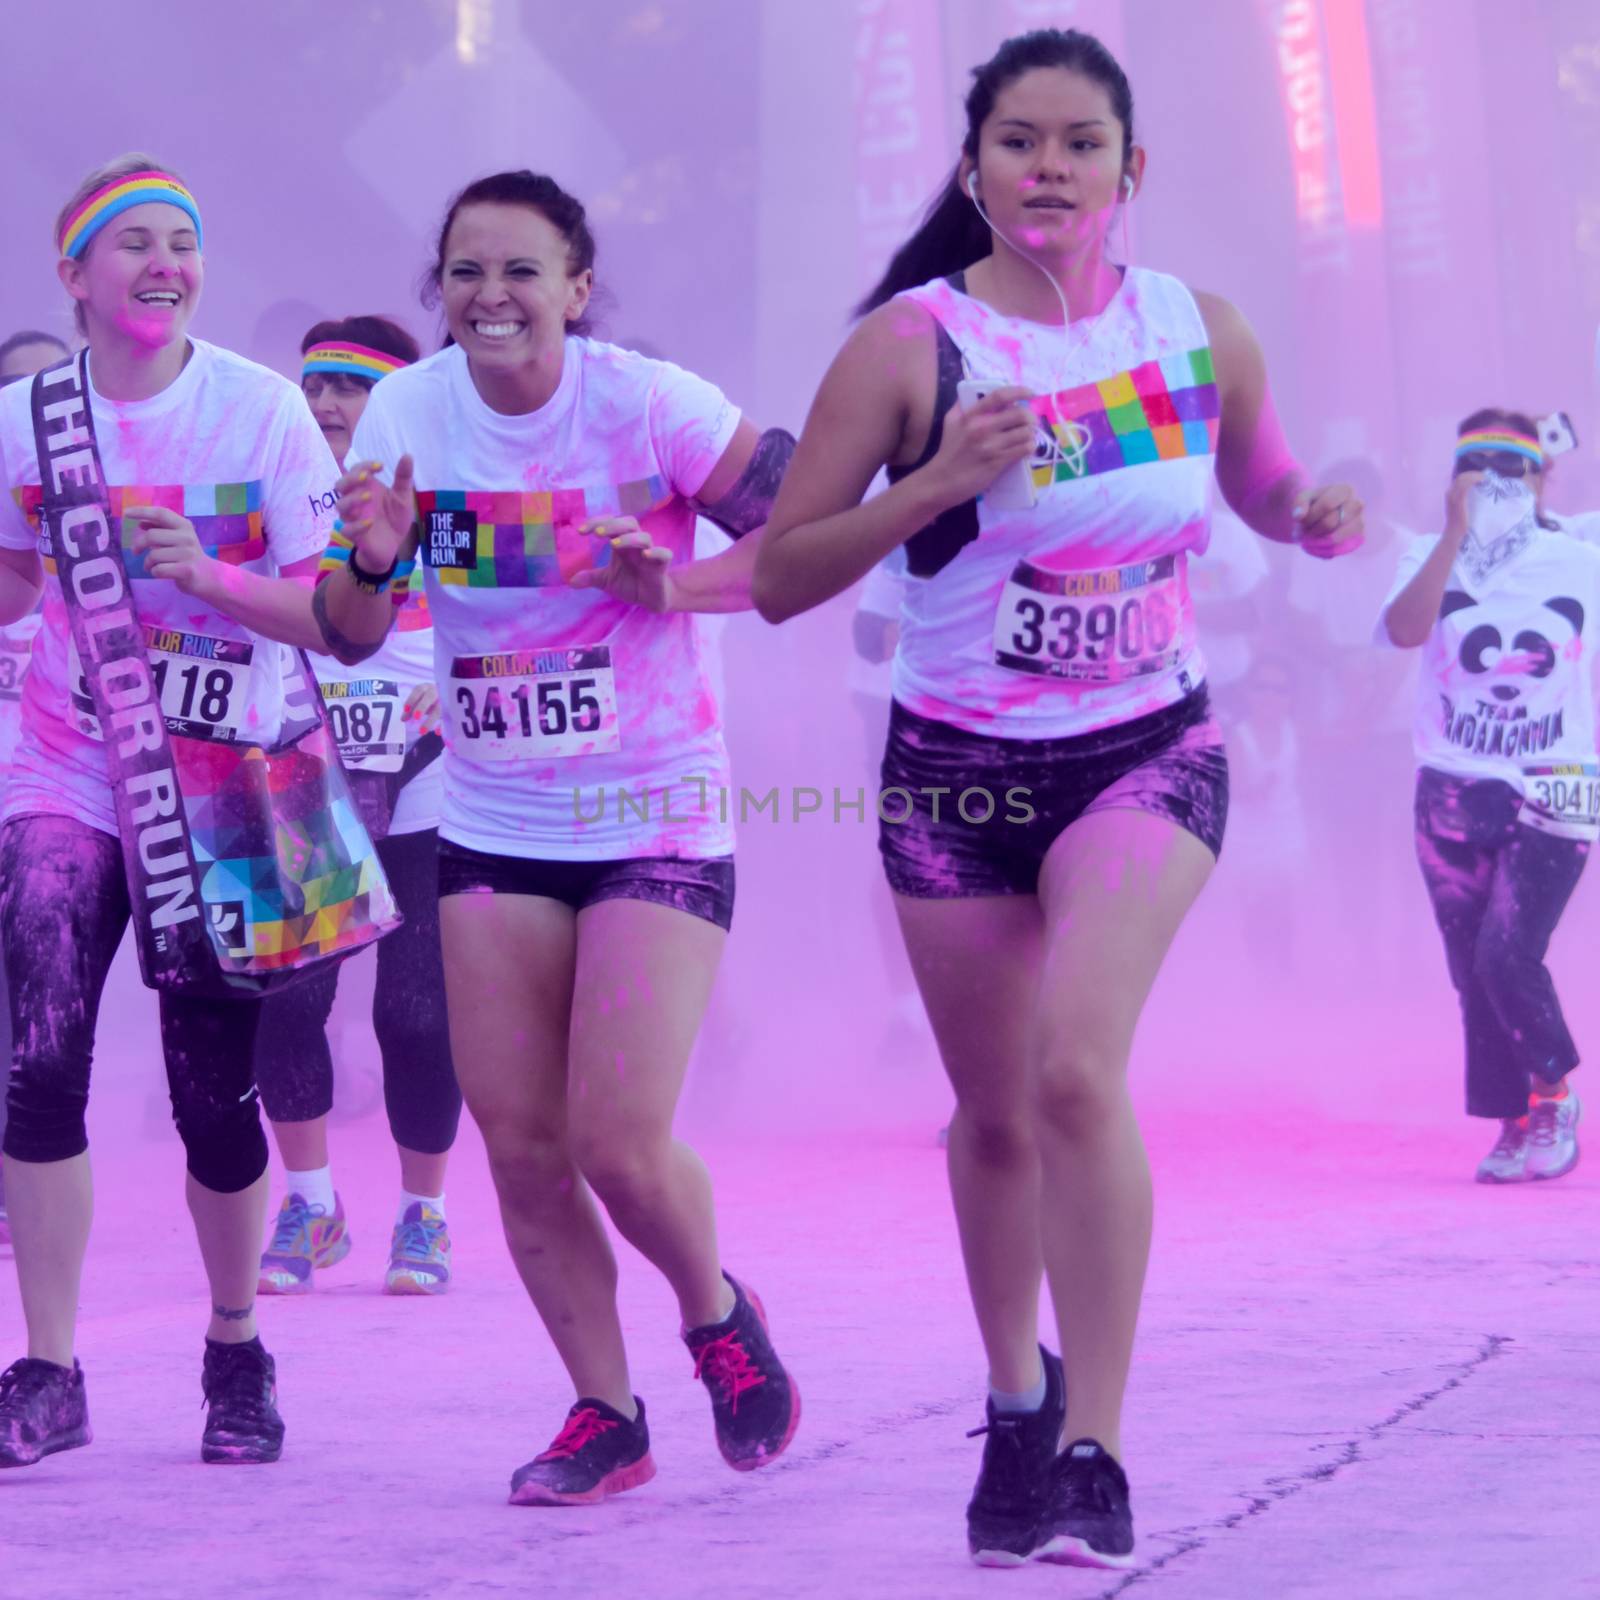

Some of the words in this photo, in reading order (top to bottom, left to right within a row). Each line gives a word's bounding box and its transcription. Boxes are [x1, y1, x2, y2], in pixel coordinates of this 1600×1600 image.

[42, 354, 99, 495] THE
[431, 512, 454, 530] THE
[431, 530, 470, 549] COLOR
[431, 547, 456, 566] RUN
[1065, 570, 1120, 598] COLOR
[1120, 565, 1147, 592] RUN
[61, 503, 163, 759] COLOR
[1012, 591, 1172, 660] 33906
[181, 634, 215, 659] RUN
[482, 653, 533, 678] COLOR
[534, 651, 568, 674] RUN
[151, 659, 234, 723] 118
[348, 680, 373, 698] RUN
[327, 701, 393, 743] 087
[456, 678, 600, 739] 34155
[1475, 699, 1528, 720] TEAM
[125, 767, 200, 930] RUN
